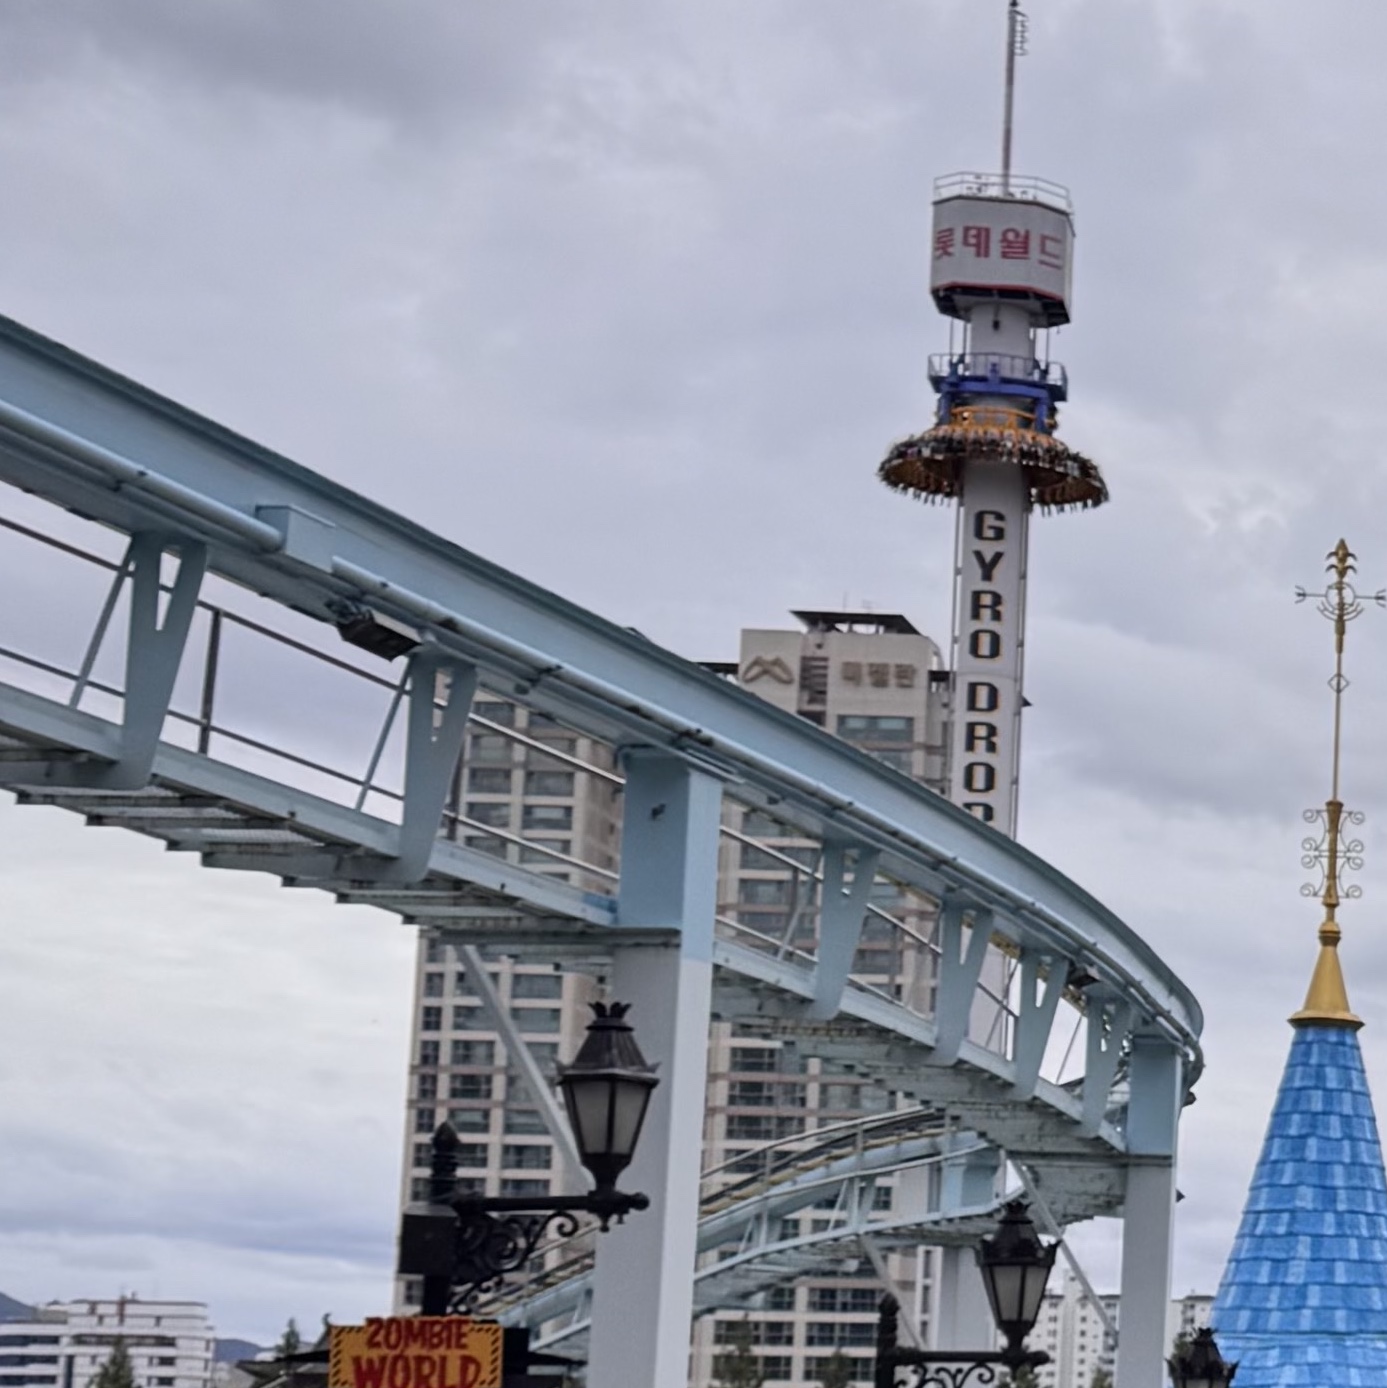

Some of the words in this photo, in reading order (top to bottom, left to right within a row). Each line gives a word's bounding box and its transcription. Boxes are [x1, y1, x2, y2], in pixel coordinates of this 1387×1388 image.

[934, 225, 1062, 270] 롯데월드
[968, 510, 1005, 659] GYRO
[366, 1318, 469, 1350] ZOMBIE
